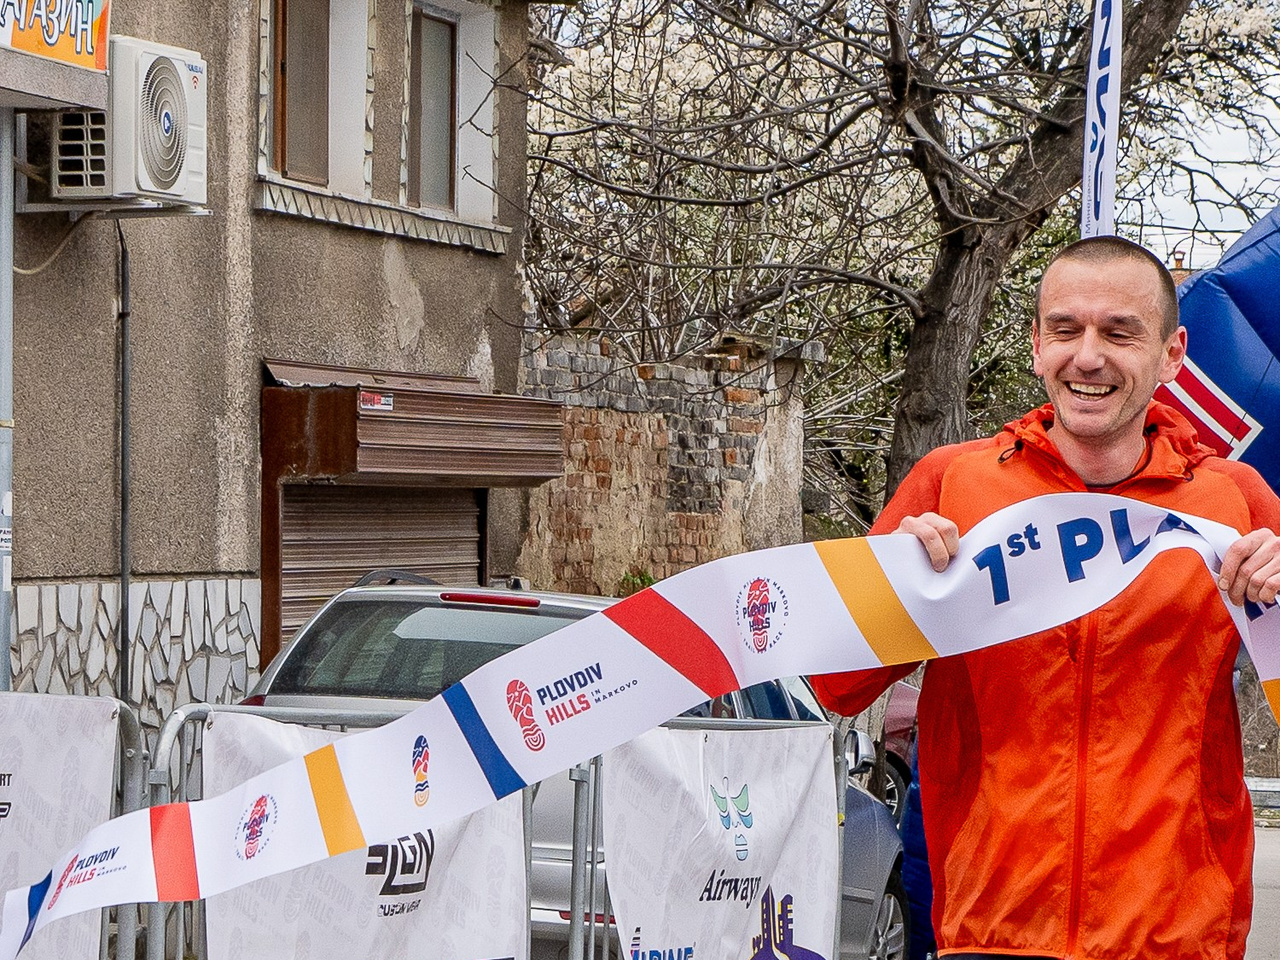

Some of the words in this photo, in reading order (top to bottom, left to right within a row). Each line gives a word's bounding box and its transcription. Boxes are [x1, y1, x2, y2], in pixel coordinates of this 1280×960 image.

[972, 523, 1041, 606] 1st
[536, 662, 603, 706] PLOVDIV
[590, 688, 602, 697] IN
[594, 679, 638, 704] MARKOVO
[545, 693, 592, 726] HILLS
[74, 846, 120, 872] PLOVDIV
[66, 867, 97, 888] HILLS
